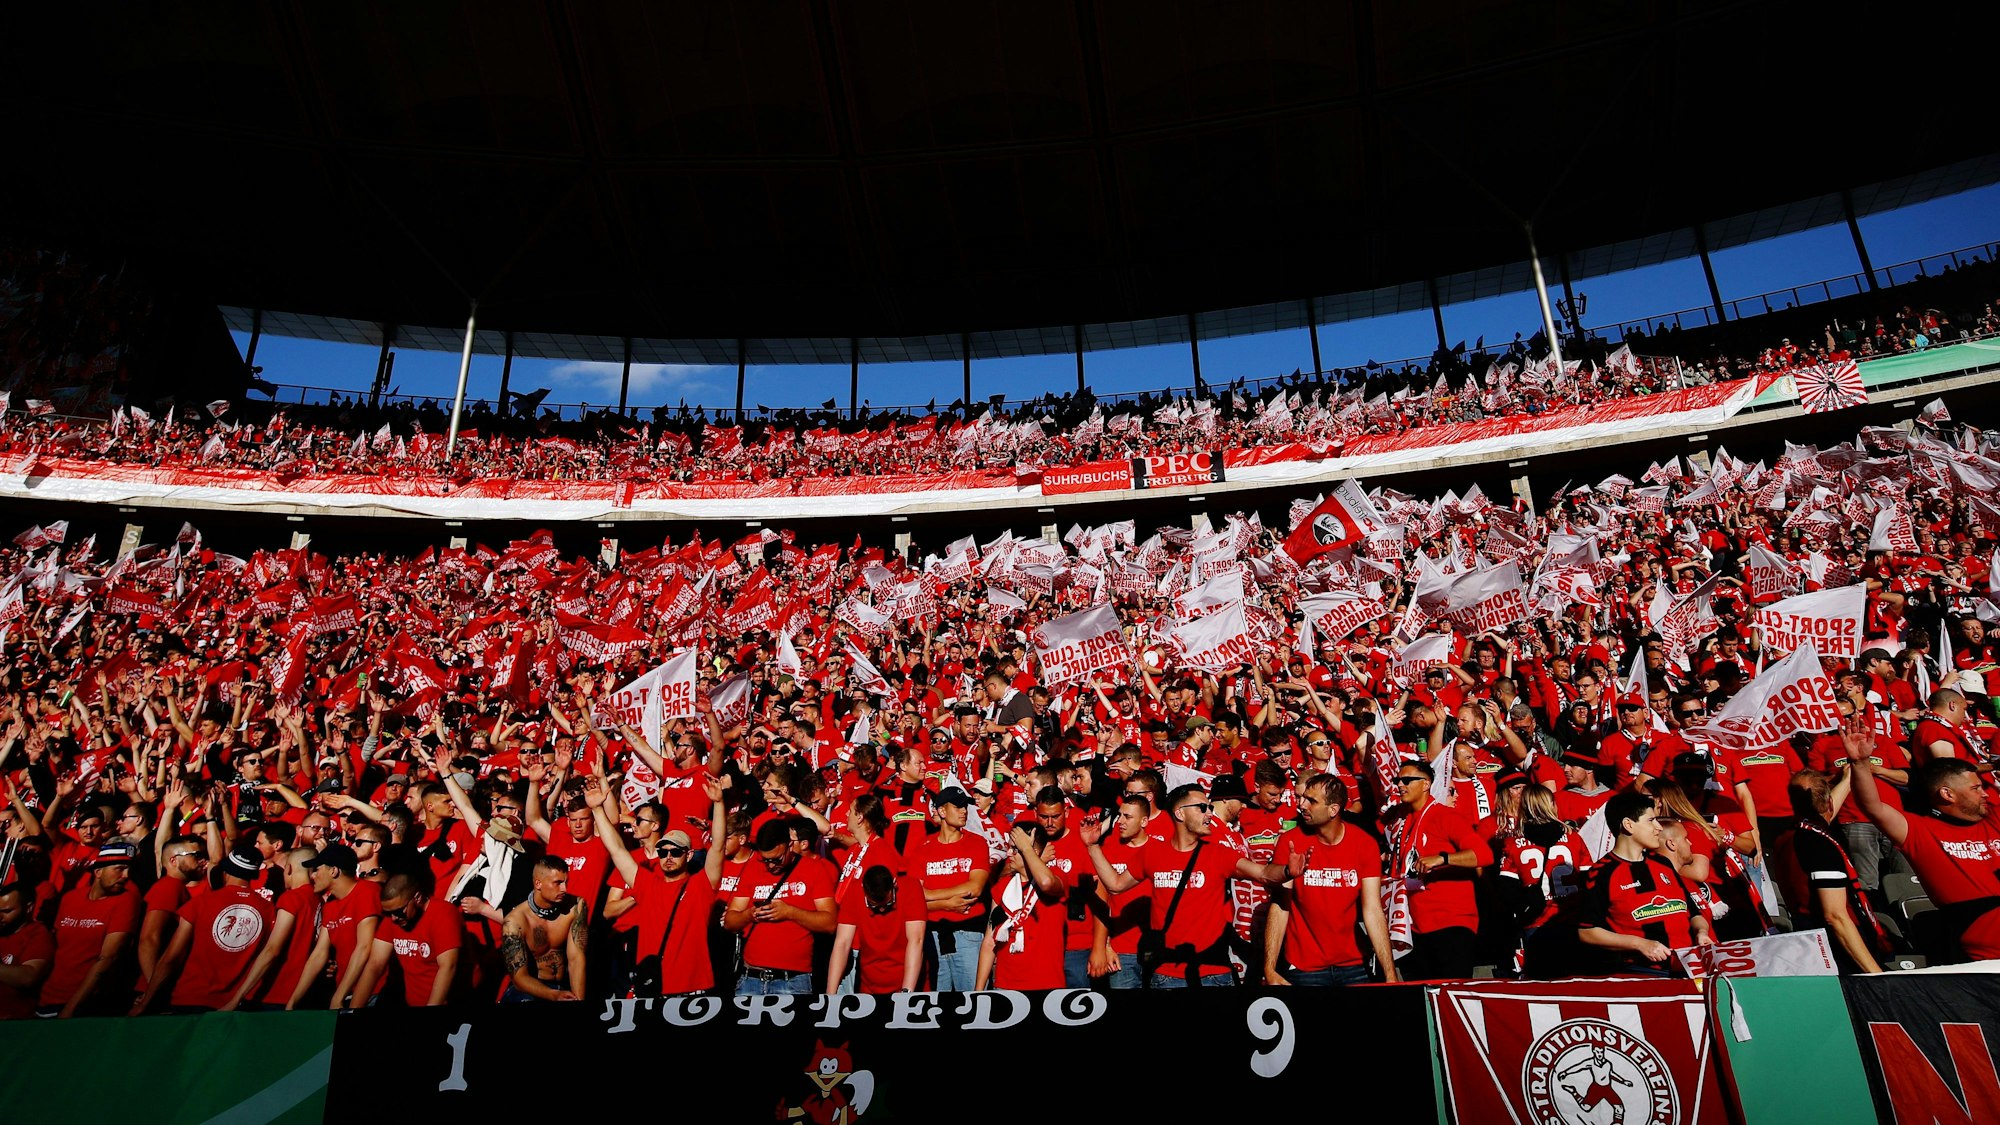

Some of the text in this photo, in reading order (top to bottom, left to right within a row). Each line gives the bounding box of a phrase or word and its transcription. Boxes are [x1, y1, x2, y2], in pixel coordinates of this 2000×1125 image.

[1143, 452, 1214, 477] PEC
[1043, 470, 1129, 486] SUHR/BUCHS
[1143, 472, 1218, 488] FREIBURG
[1326, 603, 1383, 642] FREIBURG
[1304, 869, 1342, 879] SPORT-CLUB
[1304, 878, 1335, 887] FREIBURG
[1619, 880, 1641, 891] hummel
[600, 989, 1107, 1034] TORPEDO
[1247, 997, 1296, 1078] 9
[438, 1023, 472, 1092] 1
[1531, 1025, 1671, 1114] TRADITIONSVEREIN
